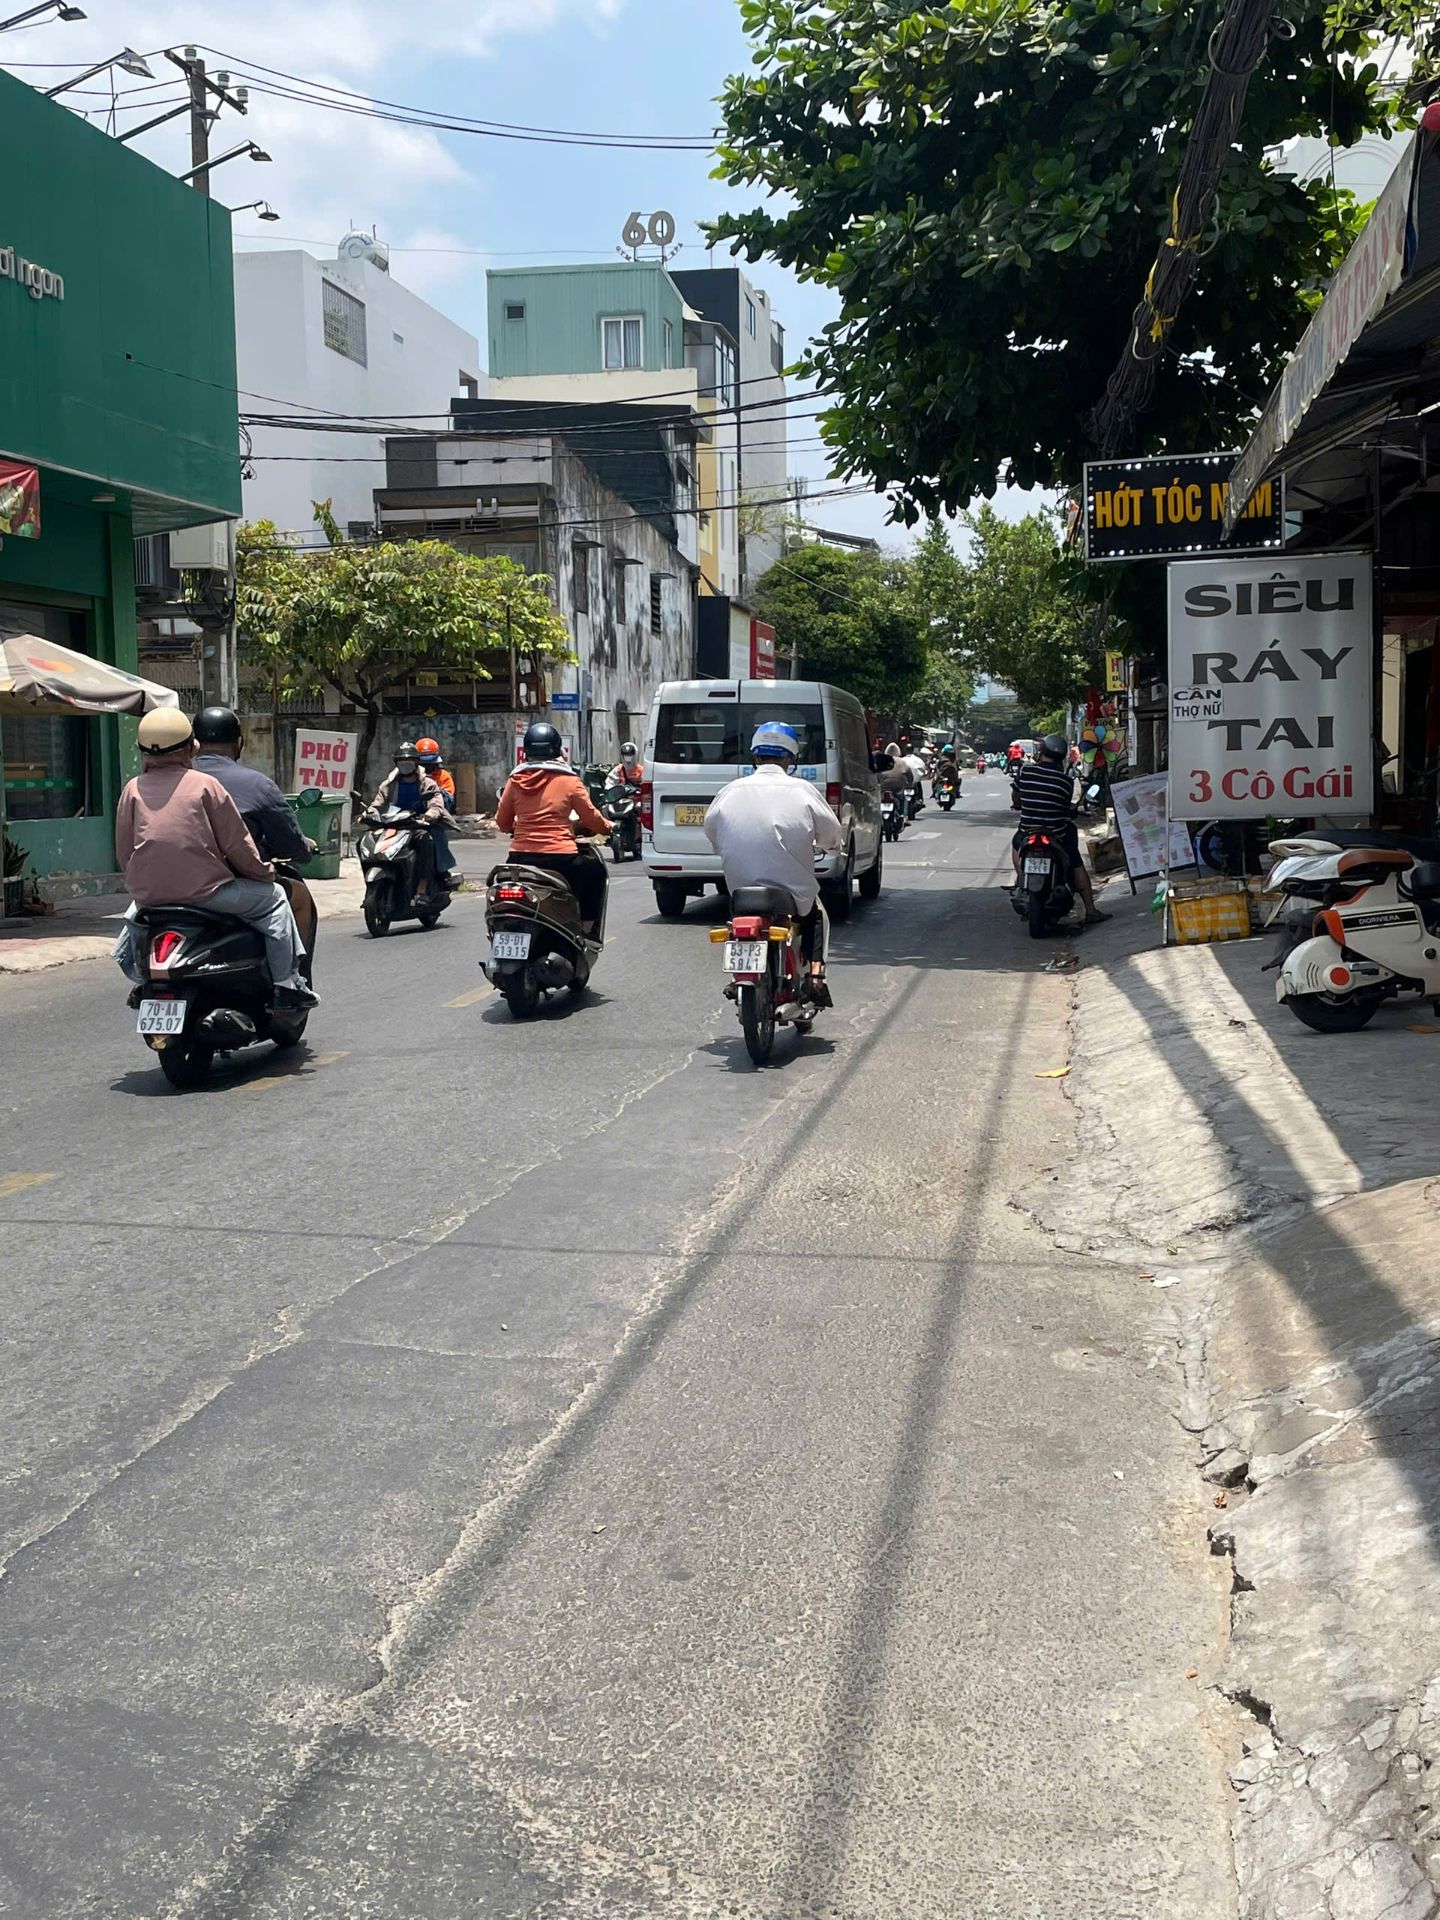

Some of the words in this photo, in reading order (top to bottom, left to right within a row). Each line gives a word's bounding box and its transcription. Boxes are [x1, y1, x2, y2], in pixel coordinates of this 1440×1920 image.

[622, 210, 675, 247] 60
[17, 256, 64, 300] ngon
[1095, 482, 1144, 528] HỚT
[1152, 477, 1202, 525] TÓC
[1211, 481, 1272, 520] NM
[1184, 572, 1355, 617] SIÊU
[1192, 639, 1355, 684] RÁY
[1174, 687, 1221, 701] CẦN
[1174, 705, 1200, 718] THỢ
[1203, 701, 1222, 716] NỮ
[1207, 716, 1335, 751] TAI
[301, 738, 349, 762] PHỞ
[299, 764, 346, 789] TÀU
[1189, 769, 1213, 803] 3
[1221, 768, 1275, 800] Cô
[1283, 765, 1353, 799] Gái
[731, 943, 761, 957] 53-P3
[730, 957, 759, 971] 5841
[147, 1003, 178, 1017] 70-AA
[140, 1017, 181, 1031] 675.07
